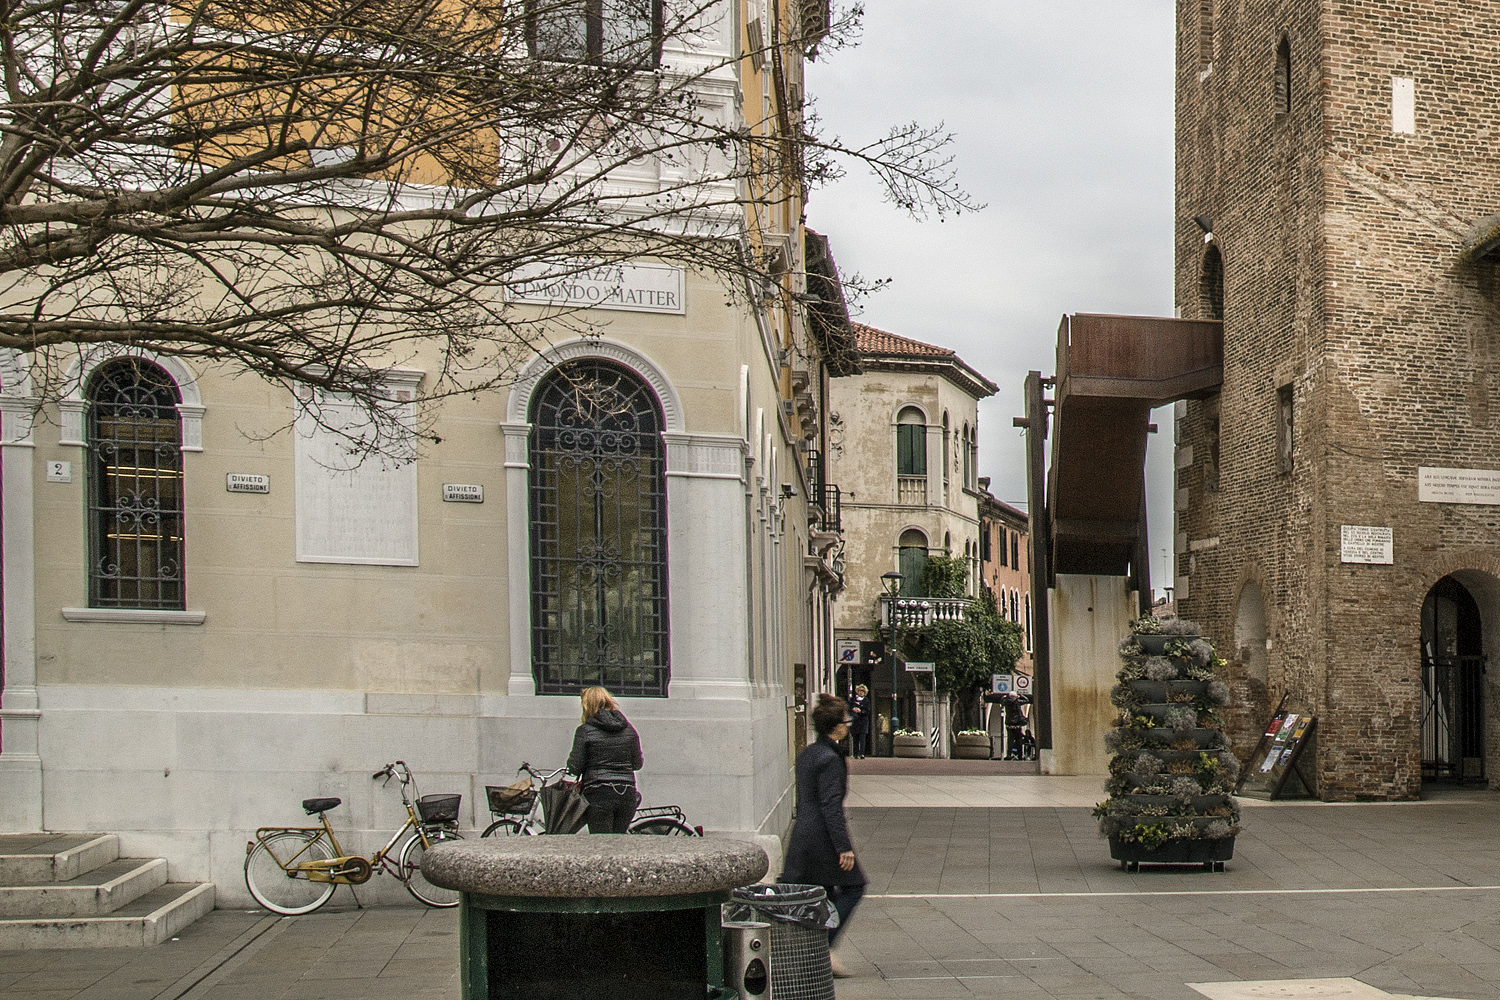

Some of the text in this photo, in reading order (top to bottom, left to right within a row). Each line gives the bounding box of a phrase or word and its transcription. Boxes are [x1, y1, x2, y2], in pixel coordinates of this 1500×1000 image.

[611, 286, 678, 307] MATTER
[54, 463, 63, 476] 2
[232, 475, 263, 483] DIVIETO
[447, 485, 478, 493] DIVIETO
